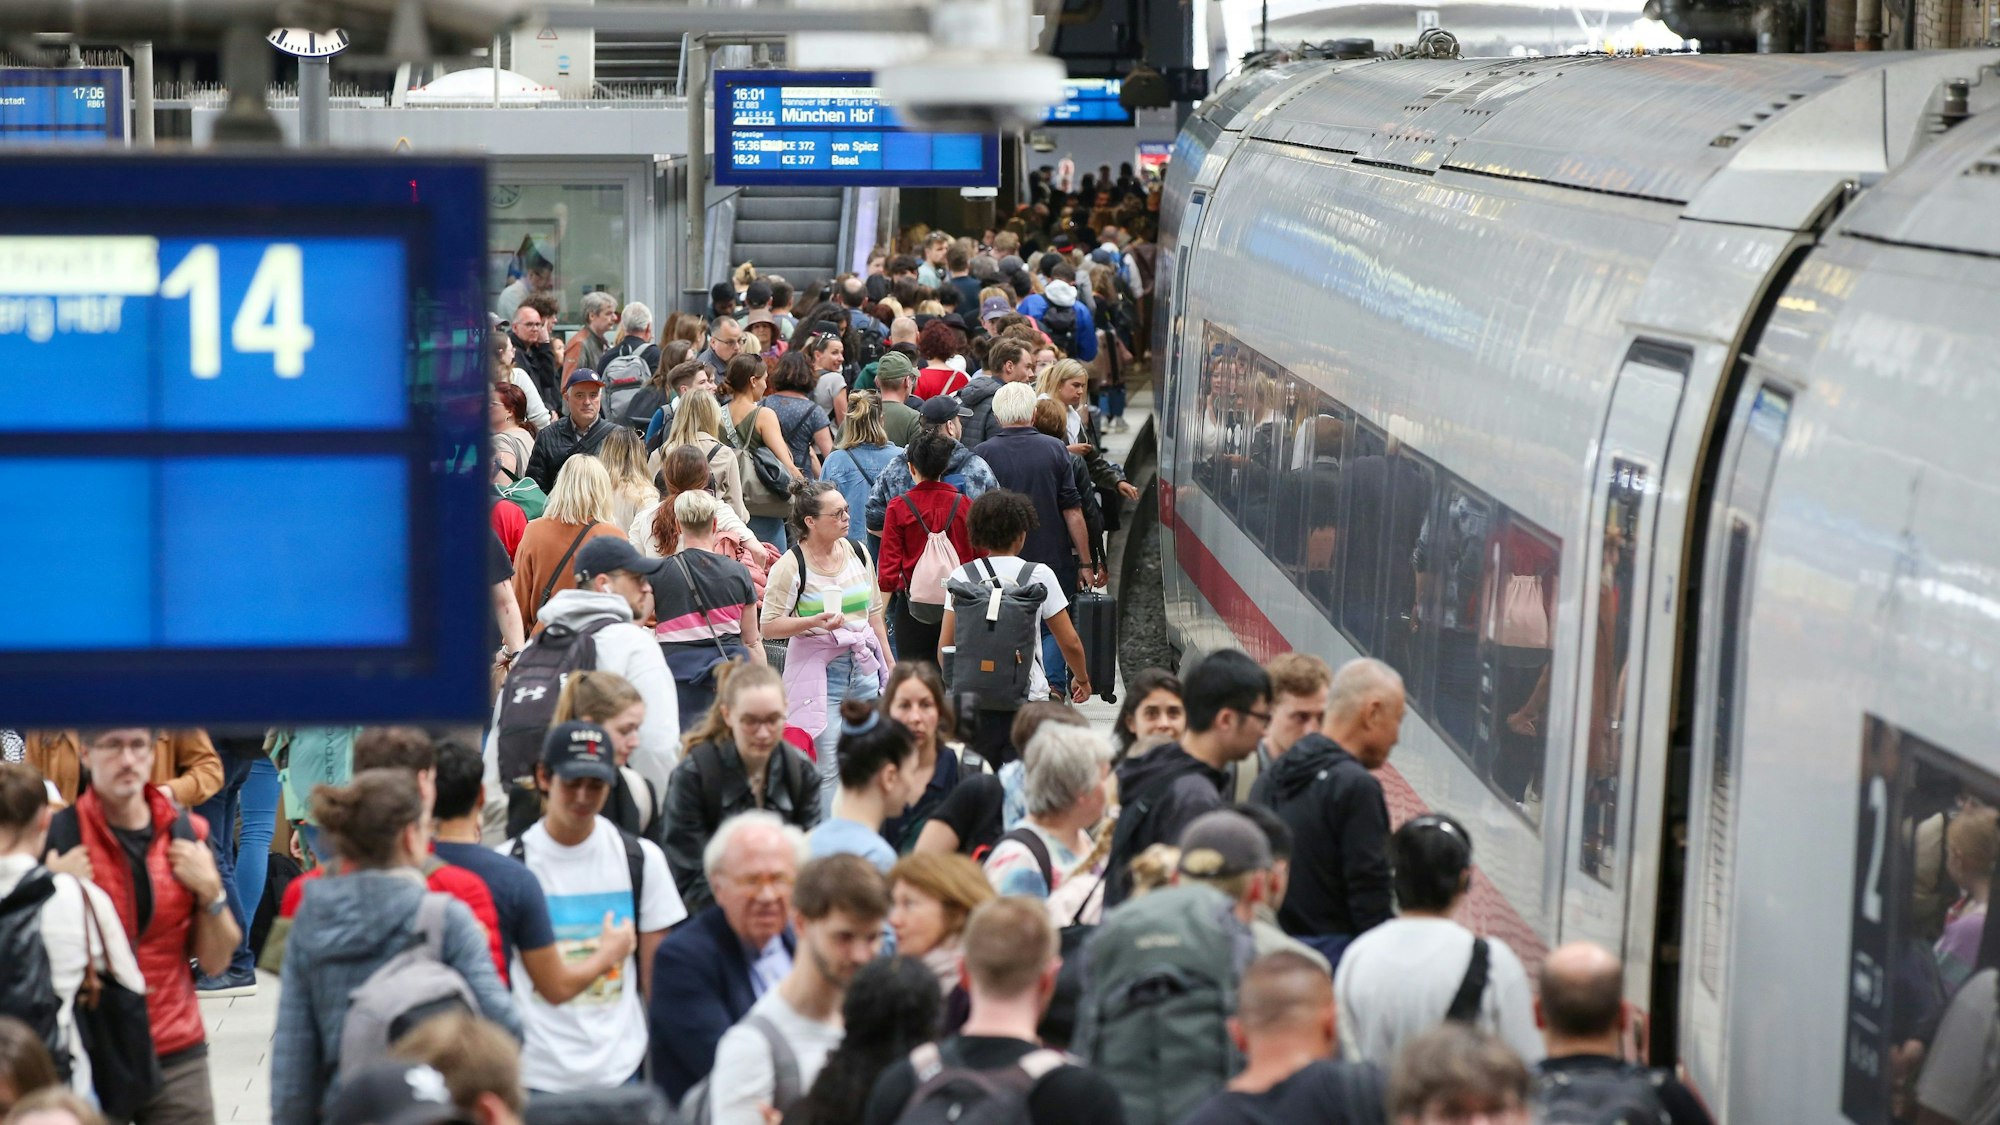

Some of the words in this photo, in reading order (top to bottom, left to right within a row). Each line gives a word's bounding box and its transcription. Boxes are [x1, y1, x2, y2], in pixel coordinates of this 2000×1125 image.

[72, 87, 104, 100] 17:06
[733, 88, 765, 100] 16:01
[733, 101, 744, 109] ICE
[782, 98, 816, 106] Hannover
[817, 98, 830, 106] Hbf
[836, 98, 859, 106] Erfurt
[782, 108, 846, 122] München
[850, 108, 874, 122] Hbf
[733, 140, 760, 150] 15:36
[798, 141, 815, 150] 372
[832, 142, 849, 151] von
[852, 141, 879, 153] Spiez
[733, 154, 760, 164] 16:24
[782, 155, 796, 164] ICE
[798, 155, 815, 164] 377
[831, 155, 859, 165] Basel
[160, 243, 315, 380] 14
